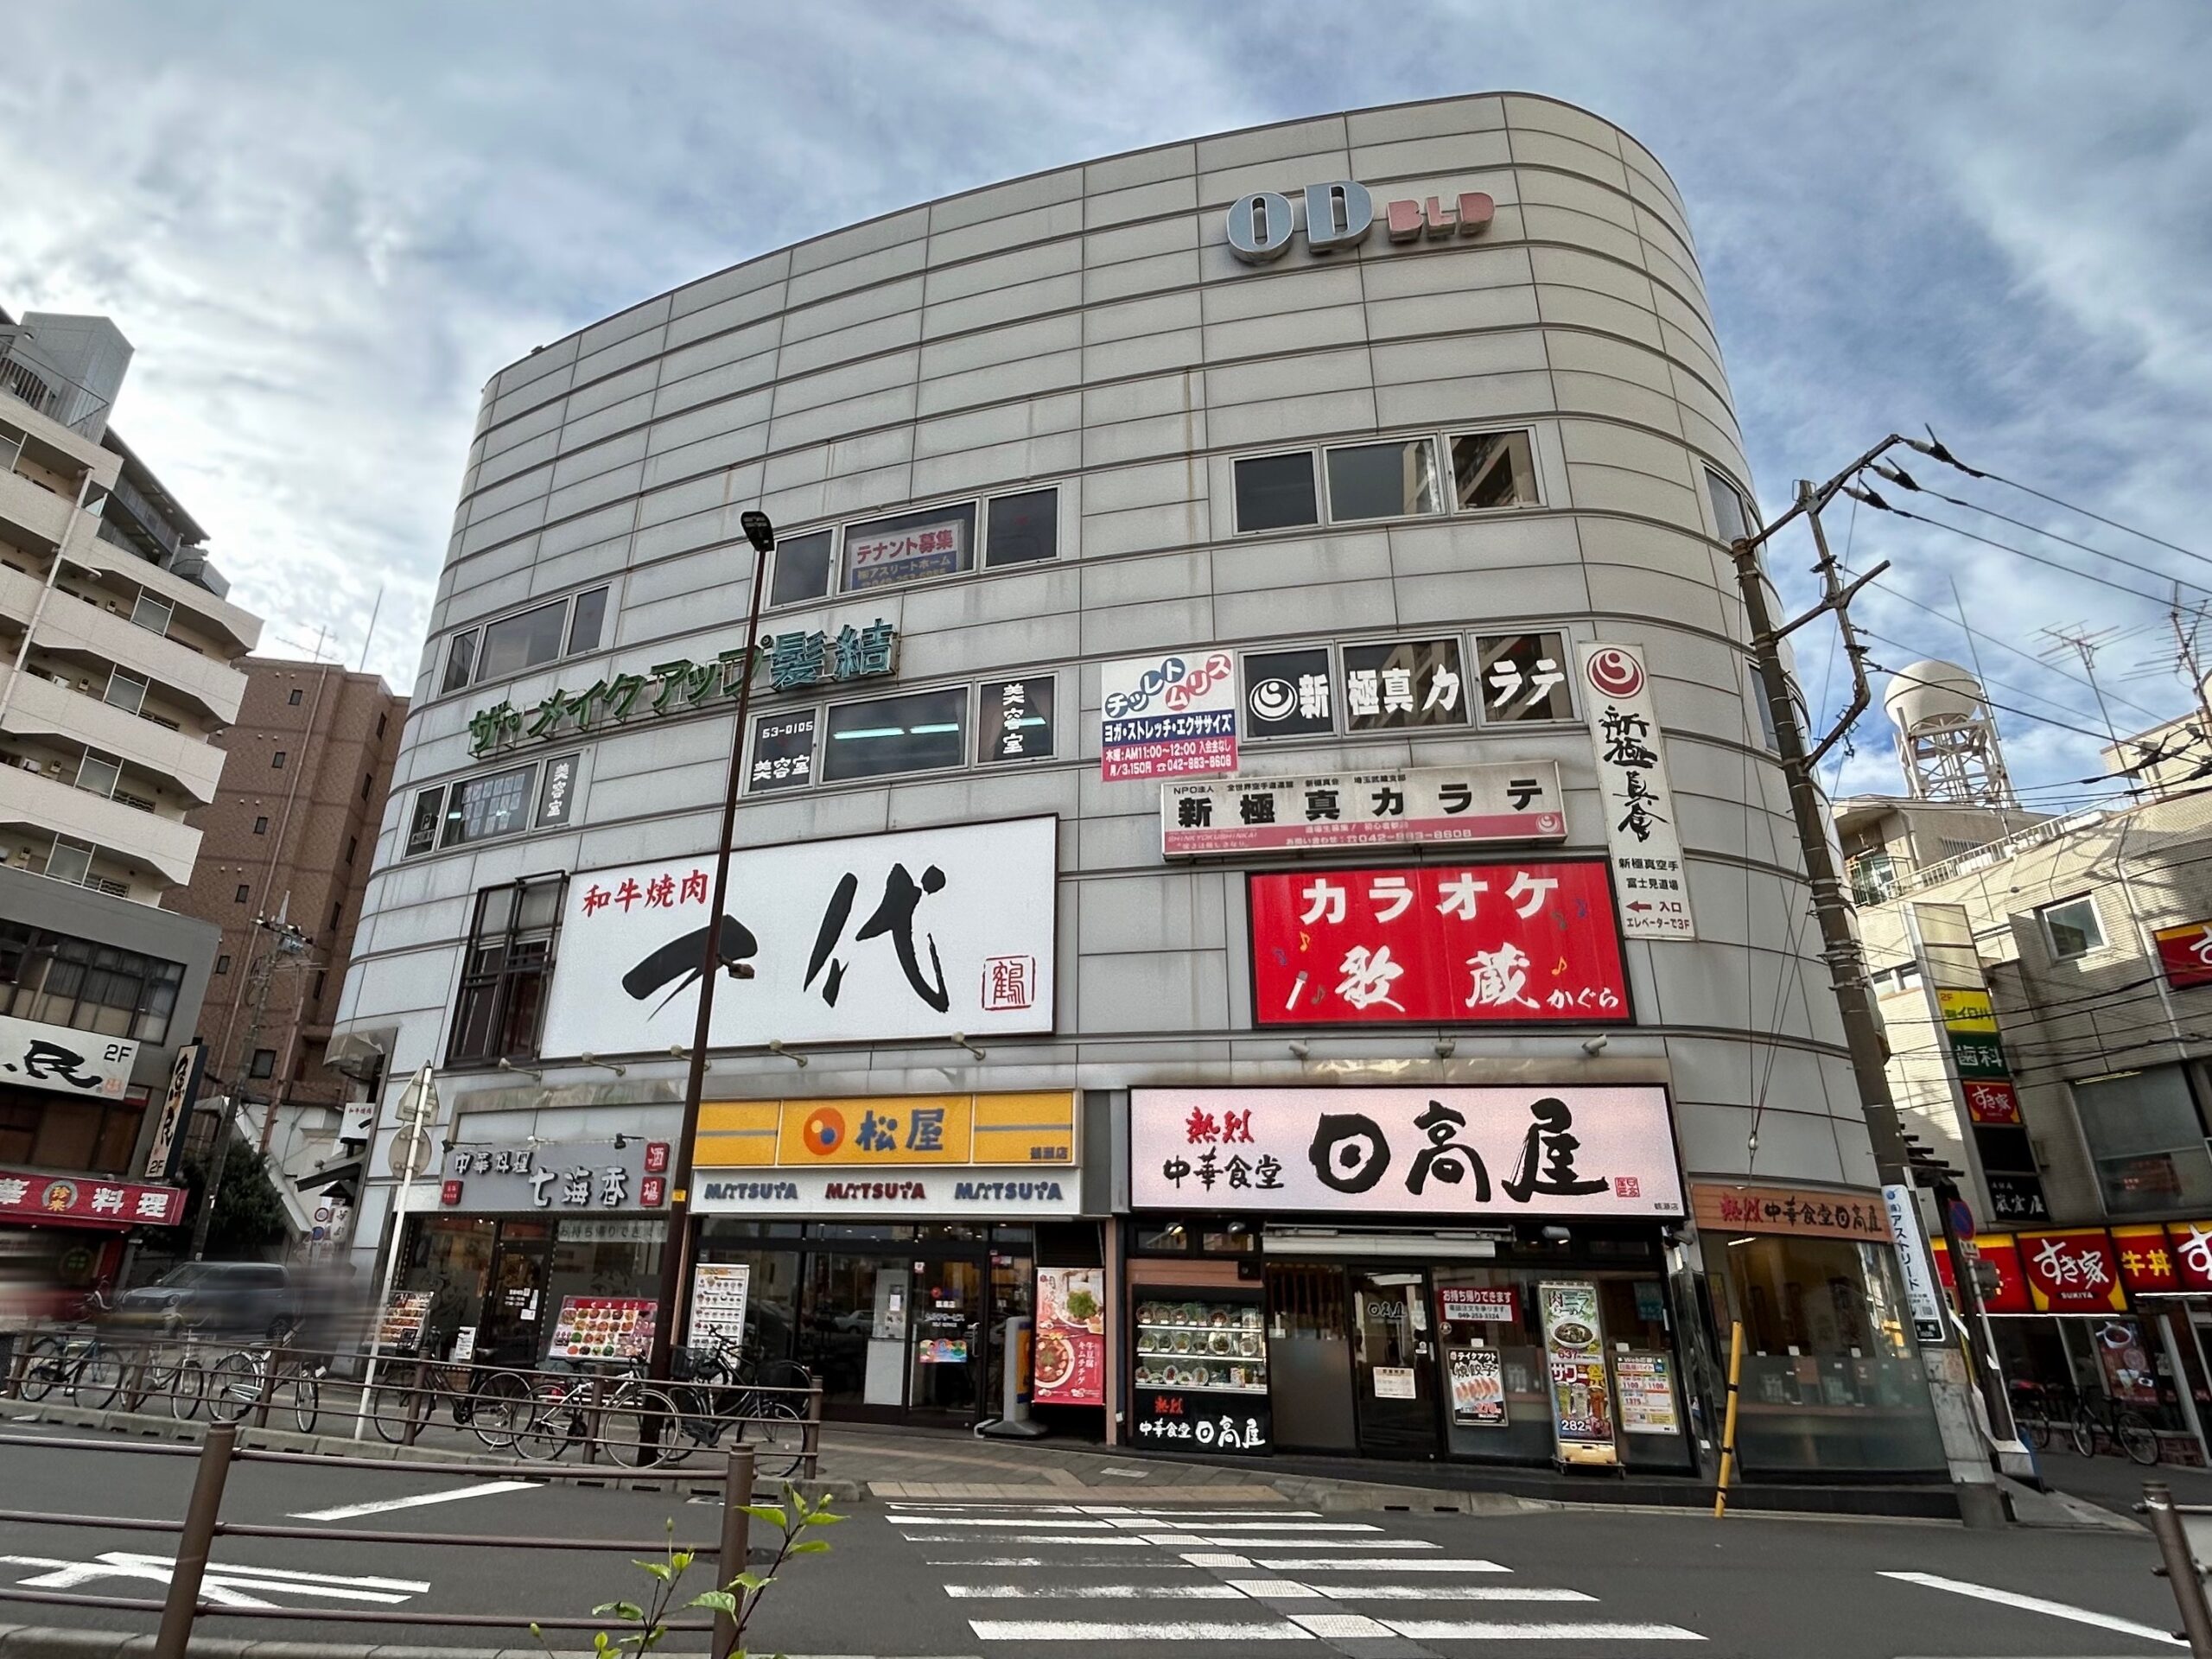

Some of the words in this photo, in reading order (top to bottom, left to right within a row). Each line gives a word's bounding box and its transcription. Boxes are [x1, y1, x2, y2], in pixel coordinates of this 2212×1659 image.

[1227, 181, 1374, 257] OD
[1387, 192, 1496, 240] BLD
[856, 530, 954, 564] テナント募集
[770, 619, 896, 691] 髪結
[1298, 658, 1565, 720] 新極真カラテ
[1002, 683, 1026, 754] 美容室
[1104, 714, 1232, 742] ヨガ・ストレッチ・エクササイズ
[752, 753, 810, 782] 美容室
[546, 762, 570, 817] 美容室
[1173, 785, 1214, 795] NPO法人
[1178, 779, 1543, 828] 新極真カラテ
[582, 868, 709, 918] 和牛焼肉
[1300, 870, 1559, 925] カラオケ
[1625, 877, 1679, 891] 富士見道場
[1659, 901, 1681, 913] 入口
[1625, 918, 1690, 931] エレベーターで3F
[622, 862, 950, 1023] 一代
[1547, 988, 1620, 1010] かぐら
[104, 1043, 132, 1064] 2F
[1955, 1045, 2003, 1068] 歯科
[1972, 1085, 2012, 1112] すき家
[855, 1108, 945, 1152] 松屋
[1185, 1106, 1255, 1145] 熱烈
[454, 1151, 533, 1175] 中華料理
[1308, 1097, 1610, 1203] 日高屋
[148, 1160, 163, 1174] 2F
[1163, 1146, 1285, 1192] 中華食堂
[527, 1166, 628, 1207] 七海香
[704, 1182, 798, 1200] MATSUYA
[825, 1181, 926, 1200] MATSUYA
[954, 1181, 1063, 1201] MATSUYA
[91, 1187, 169, 1218] 料理
[2032, 1237, 2110, 1290] すき家
[2121, 1249, 2172, 1277] 牛丼
[1442, 1289, 1512, 1304] お持ち帰りできます
[1548, 1290, 1591, 1307] 肉ニラ
[1457, 1352, 1497, 1361] テイクアウト
[1139, 1418, 1192, 1439] 中華食堂
[1195, 1415, 1266, 1449] 日高屋
